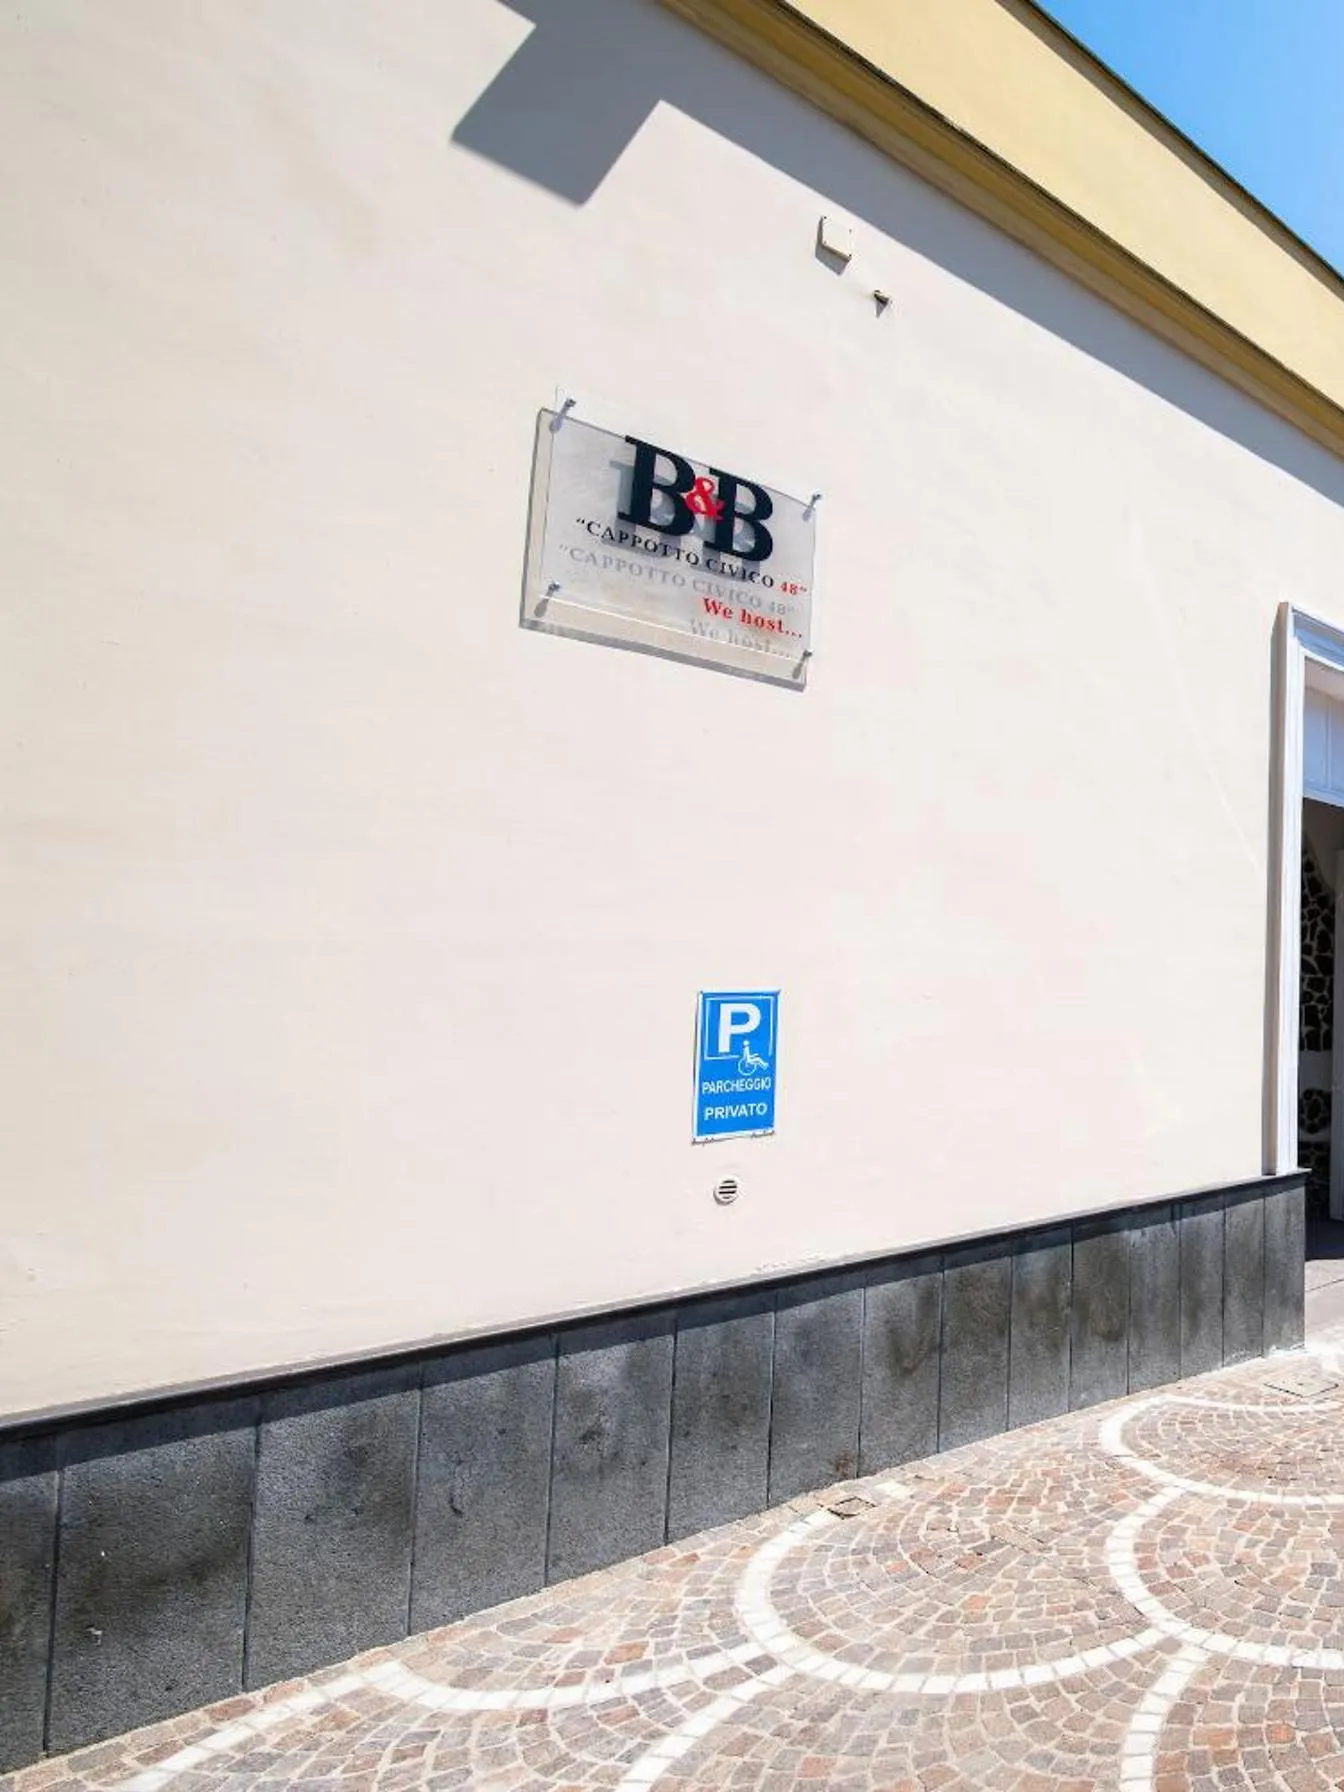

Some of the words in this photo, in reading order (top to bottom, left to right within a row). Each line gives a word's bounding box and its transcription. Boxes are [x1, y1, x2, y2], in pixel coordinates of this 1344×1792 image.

[617, 435, 773, 562] B&B
[706, 558, 774, 589] CIVICO
[703, 598, 733, 619] We
[740, 607, 803, 639] host...
[718, 1003, 761, 1055] P
[702, 1076, 771, 1095] PARCHEGGIO
[704, 1102, 768, 1121] PRIVATO
